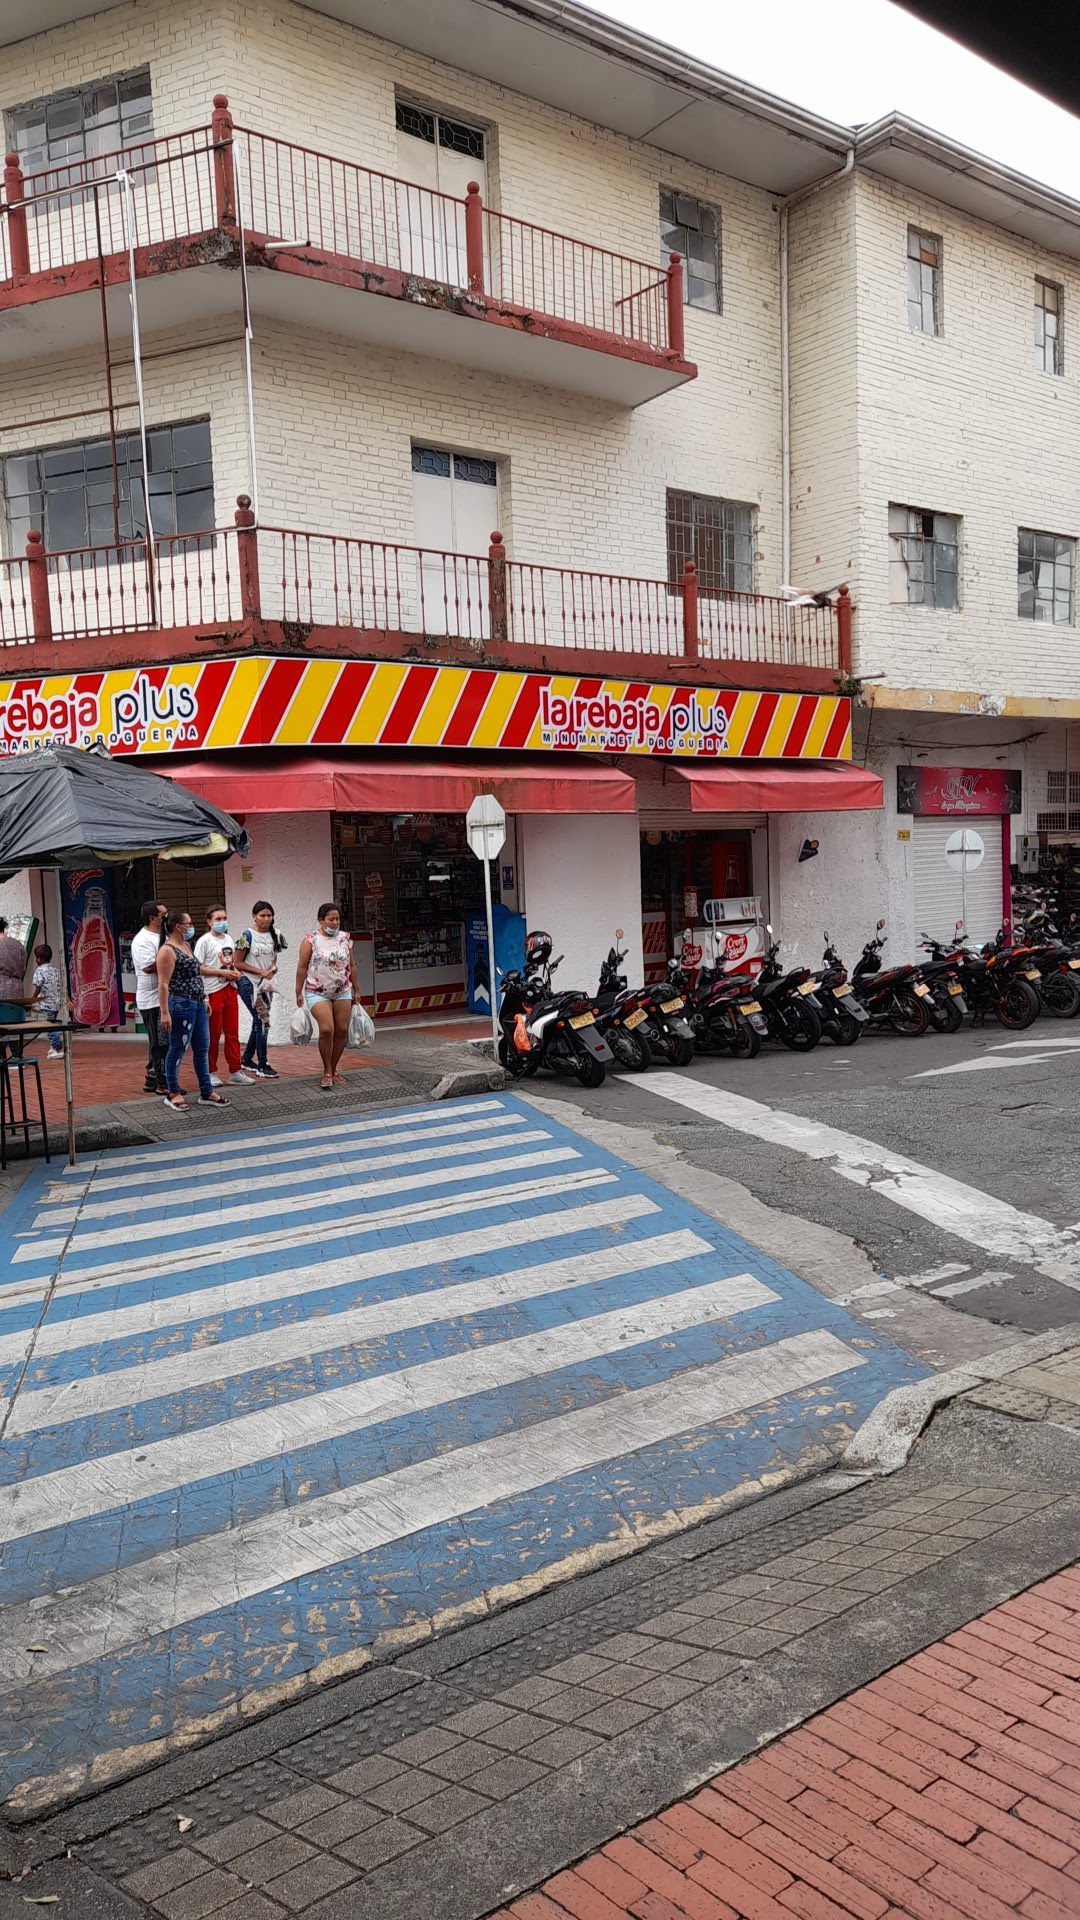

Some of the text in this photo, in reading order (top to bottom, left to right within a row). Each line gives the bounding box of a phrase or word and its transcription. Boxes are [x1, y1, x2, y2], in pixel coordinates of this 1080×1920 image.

[115, 679, 194, 734] plus
[672, 697, 727, 740] plus
[84, 728, 197, 745] DROGUERIA
[542, 732, 729, 749] MINIMARKET DROGUERIA
